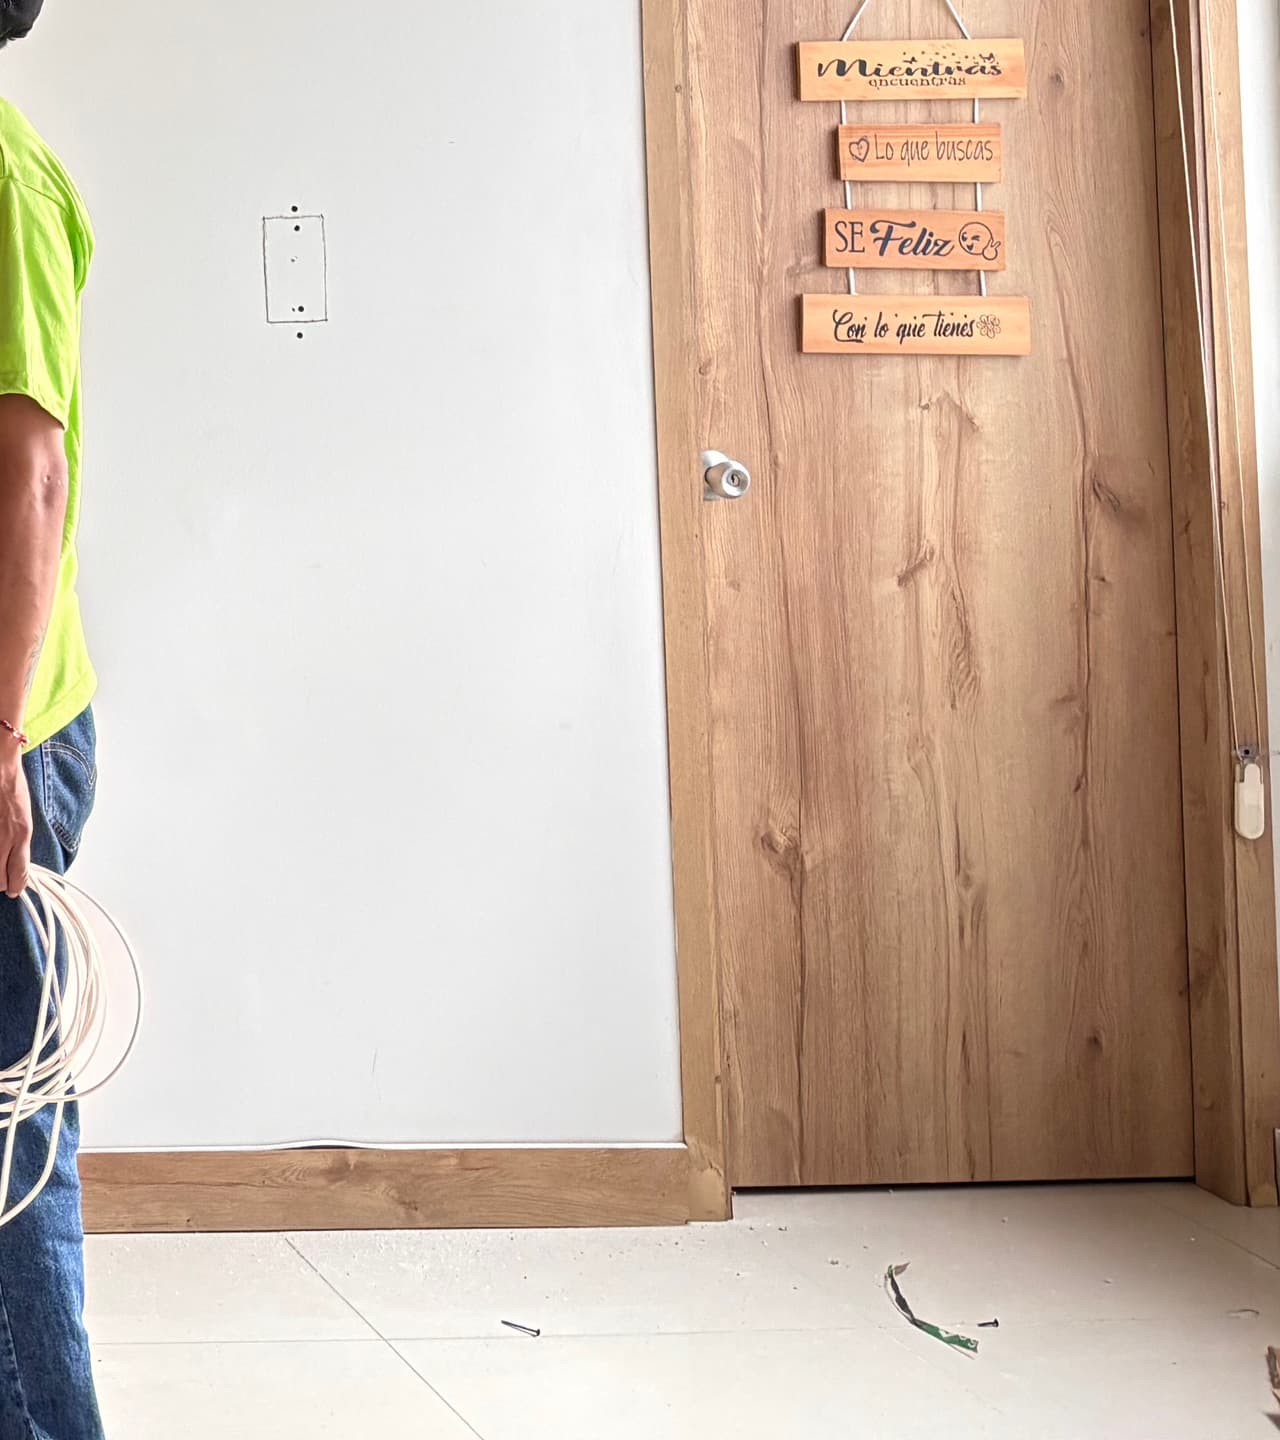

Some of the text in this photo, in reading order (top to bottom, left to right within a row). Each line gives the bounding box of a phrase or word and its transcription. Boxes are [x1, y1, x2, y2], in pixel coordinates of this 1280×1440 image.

[817, 57, 1002, 78] Mientras
[874, 131, 994, 167] Lo que buscas
[834, 219, 955, 257] SE Feliz
[833, 308, 976, 345] Con lo que tienes
